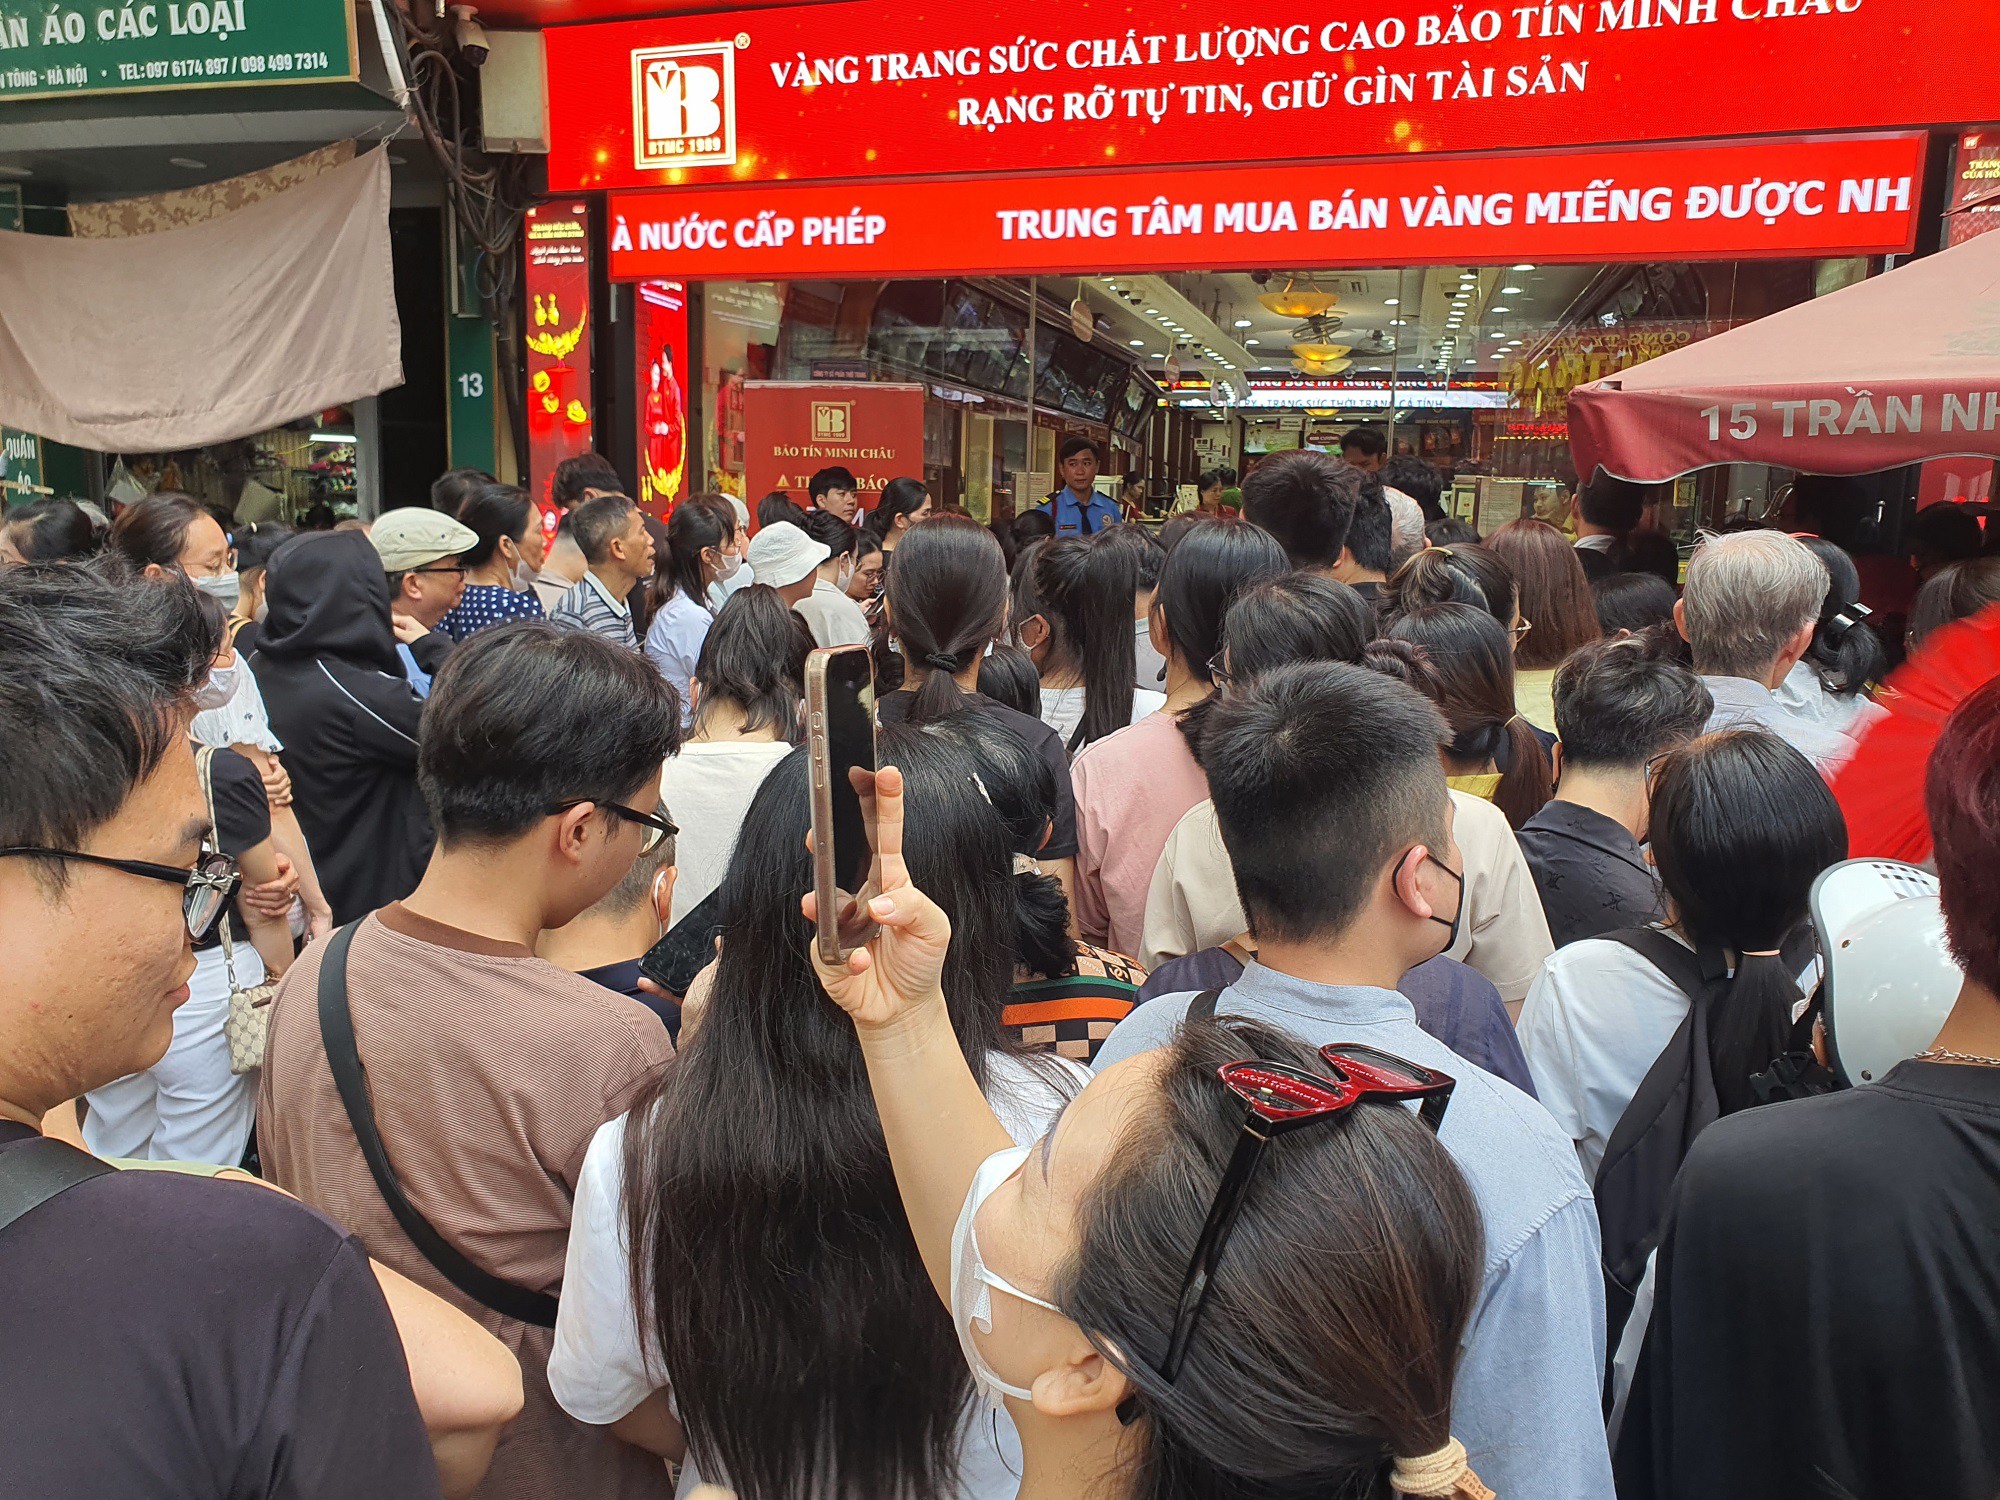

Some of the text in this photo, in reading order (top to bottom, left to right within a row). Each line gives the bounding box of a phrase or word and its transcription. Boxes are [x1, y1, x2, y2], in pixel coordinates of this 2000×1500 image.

[43, 4, 86, 45] ÁO
[97, 0, 159, 41] CÁC
[168, 0, 247, 42] LOẠI
[769, 52, 859, 88] VÀNG
[865, 47, 981, 82] TRANG
[989, 35, 1058, 74] SỨC
[1066, 28, 1167, 69] CHẤT
[1174, 25, 1310, 66] LƯỢNG
[1320, 18, 1406, 52] CAO
[1414, 3, 1502, 46] BẢO
[1511, 0, 1584, 39] TÍN
[1595, 0, 1718, 33] MINH
[172, 59, 203, 77] 6174
[205, 57, 228, 76] 897
[240, 55, 266, 74] 098
[268, 53, 293, 72] 499
[295, 51, 329, 70] 7314
[958, 94, 1054, 132] RẠNG
[1121, 82, 1176, 124] TỰ
[1180, 83, 1253, 117] TIN,
[1262, 72, 1339, 110] GIỮ
[1343, 66, 1417, 106] GÌN
[1426, 60, 1496, 101] TÀI
[1505, 54, 1589, 97] SẢN
[648, 137, 721, 155] BTMC 1989
[611, 214, 634, 252] À
[640, 212, 728, 251] NƯỚC
[802, 206, 887, 246] PHÉP
[996, 176, 1912, 240] TRUNG TÂM MUA BÁN VÀNG MIẾNG ĐƯỢC NH
[458, 372, 484, 398] 13
[1700, 402, 1757, 441] 15
[1772, 386, 1923, 438] TRẦN
[801, 445, 822, 457] TÍN
[825, 448, 858, 458] MINH
[861, 447, 896, 459] CHÂU
